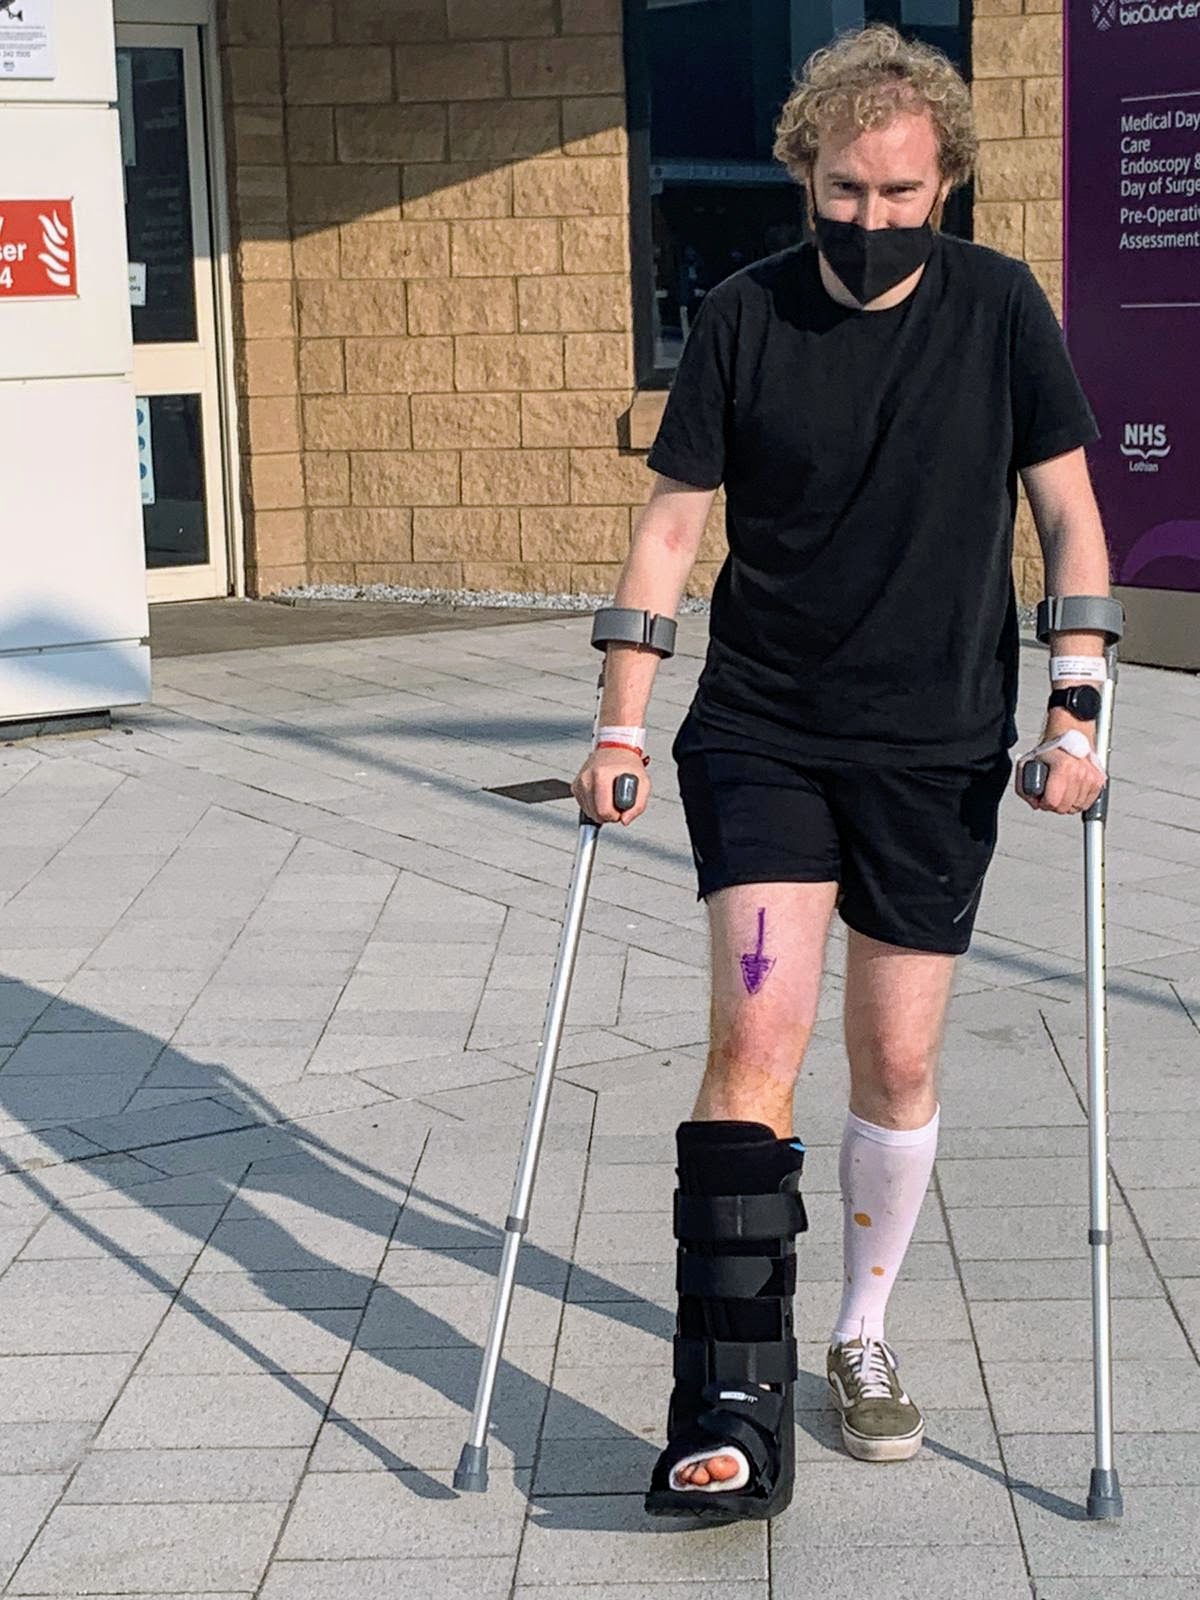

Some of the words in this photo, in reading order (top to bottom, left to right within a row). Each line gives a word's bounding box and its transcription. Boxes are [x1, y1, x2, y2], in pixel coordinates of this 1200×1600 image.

[1120, 2, 1200, 25] bioQuarter
[1121, 111, 1172, 132] Medical
[1175, 111, 1200, 131] Day
[1121, 137, 1151, 154] Care
[1121, 157, 1191, 175] Endoscopy
[1194, 153, 1200, 170] &
[1121, 180, 1146, 200] Day
[1149, 177, 1163, 195] of
[1119, 232, 1200, 249] Assessment
[1124, 423, 1167, 446] NHS
[1129, 460, 1159, 472] Lothian
